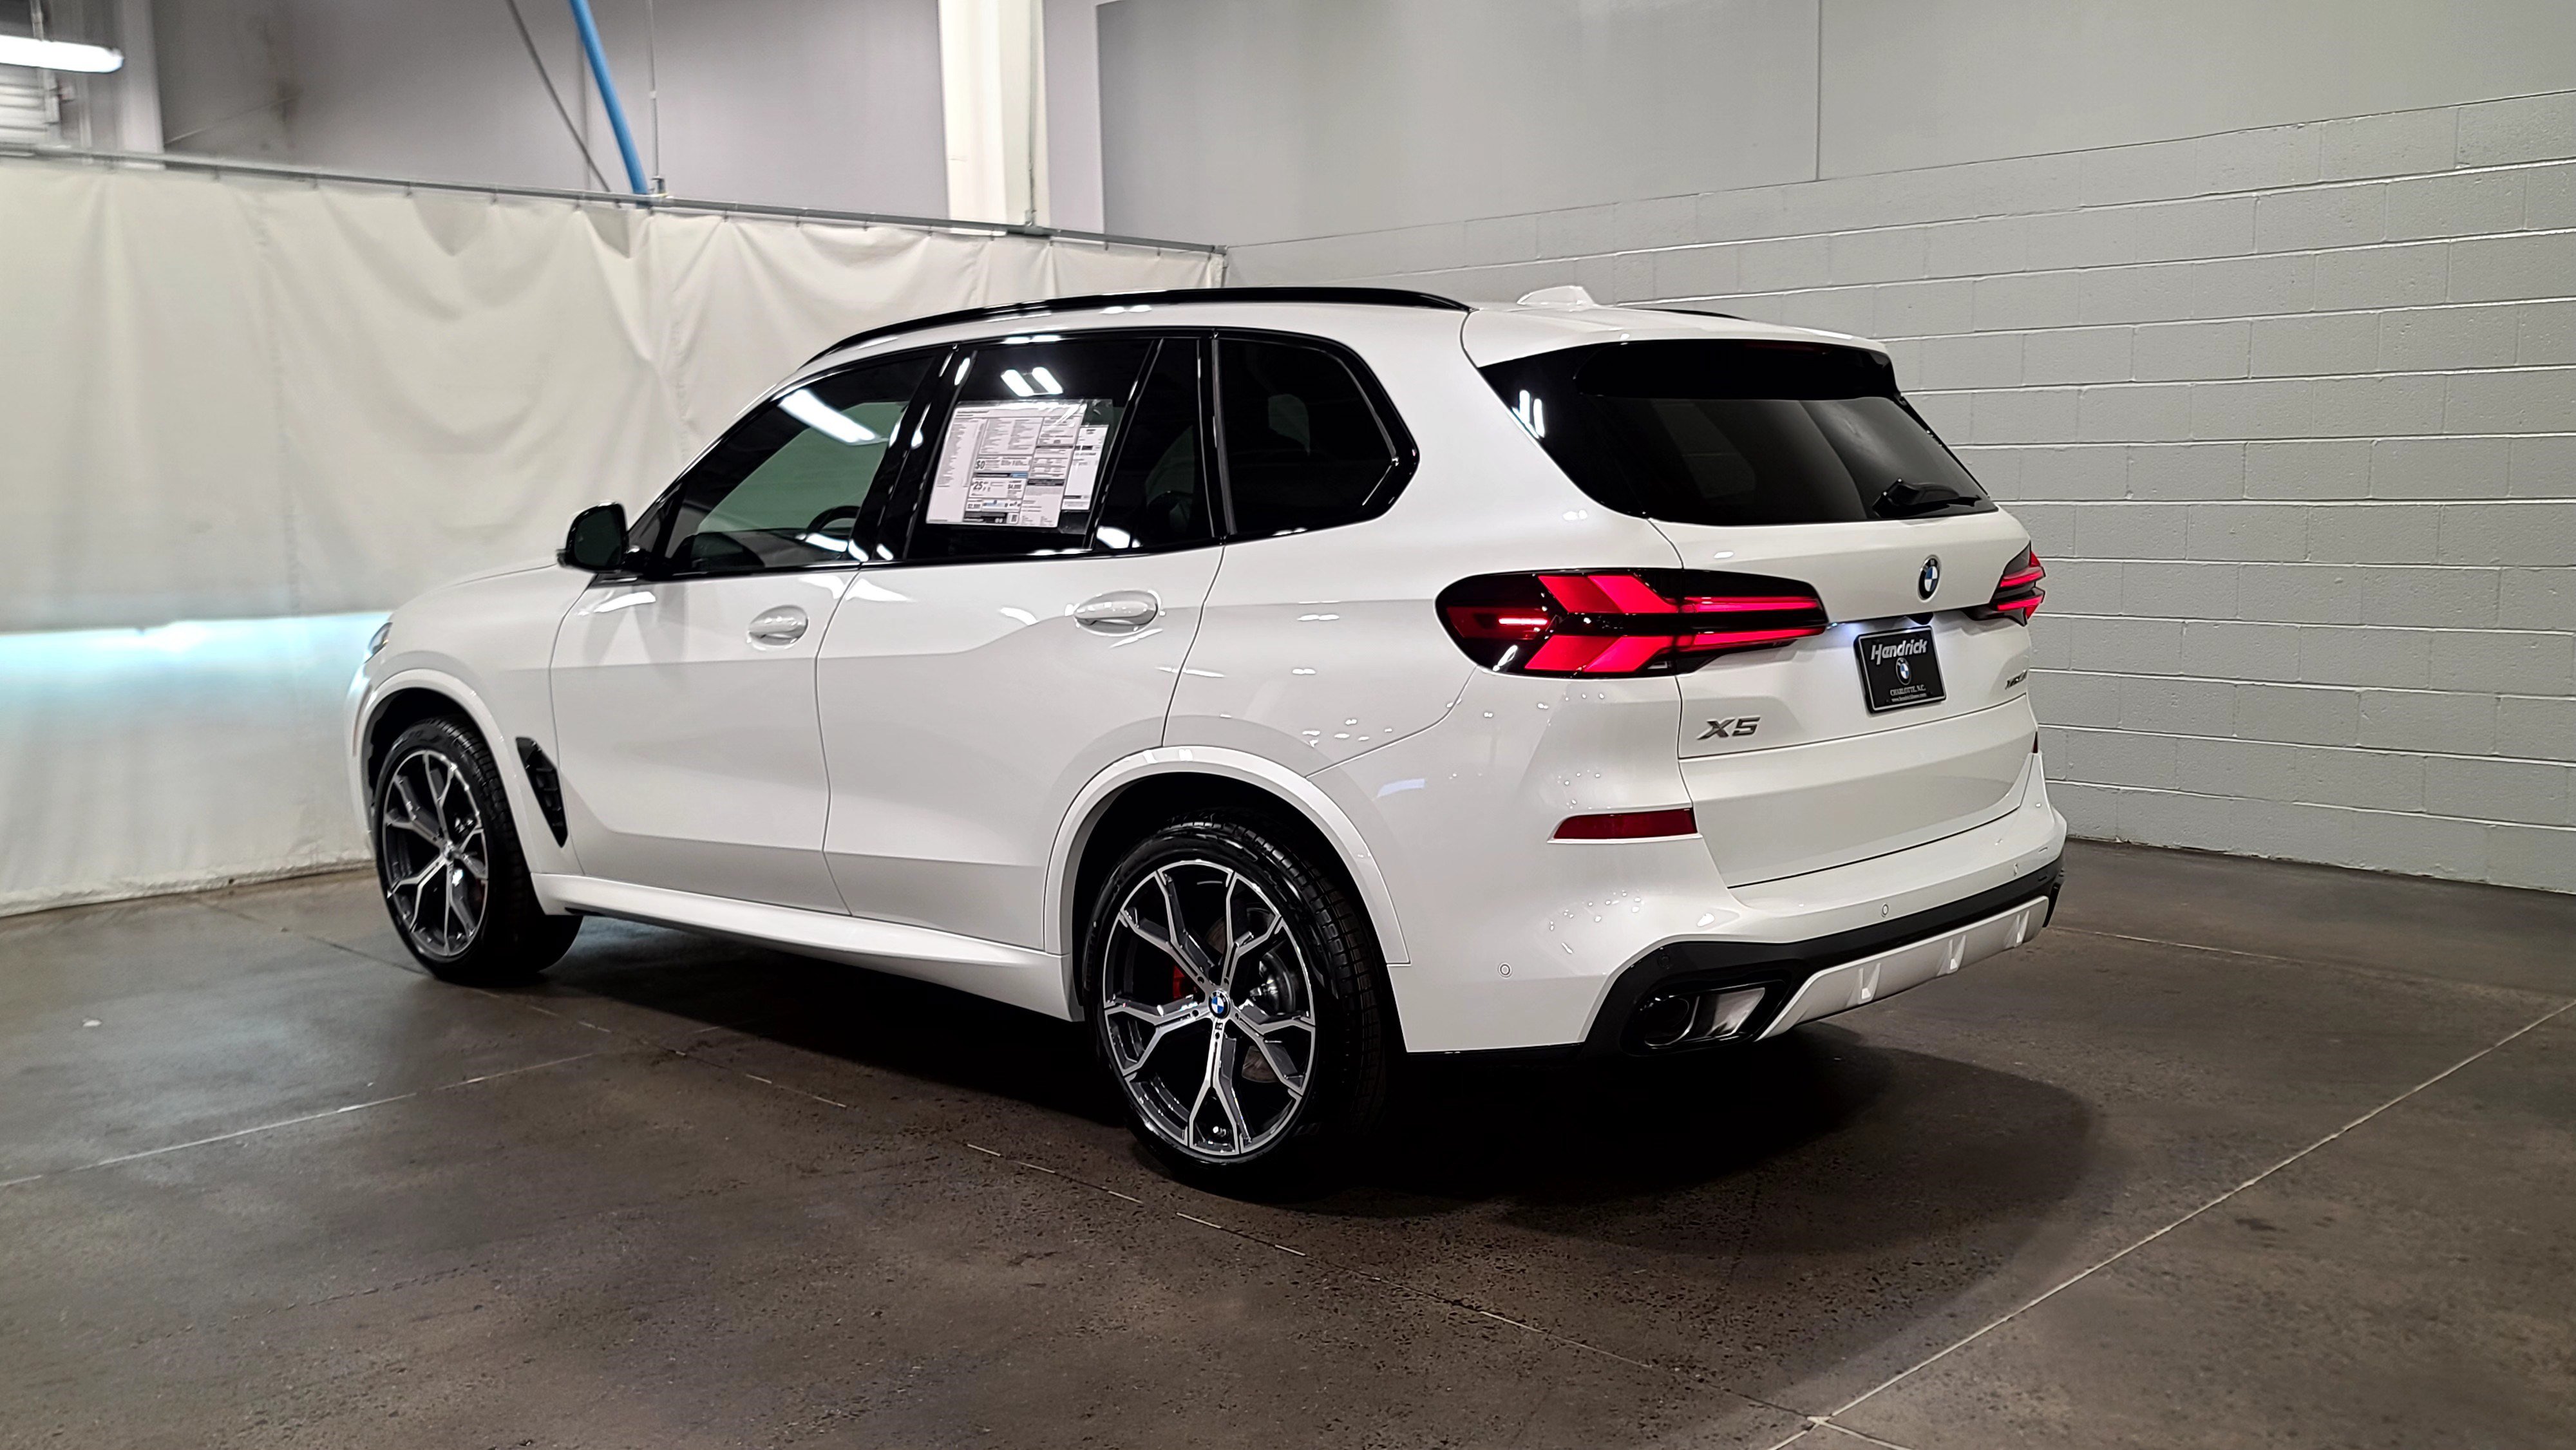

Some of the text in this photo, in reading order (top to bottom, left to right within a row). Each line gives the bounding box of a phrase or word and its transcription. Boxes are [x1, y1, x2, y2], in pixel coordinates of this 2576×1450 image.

[973, 481, 983, 490] 25
[1871, 639, 1927, 665] Hendrick
[1696, 715, 1761, 740] X5
